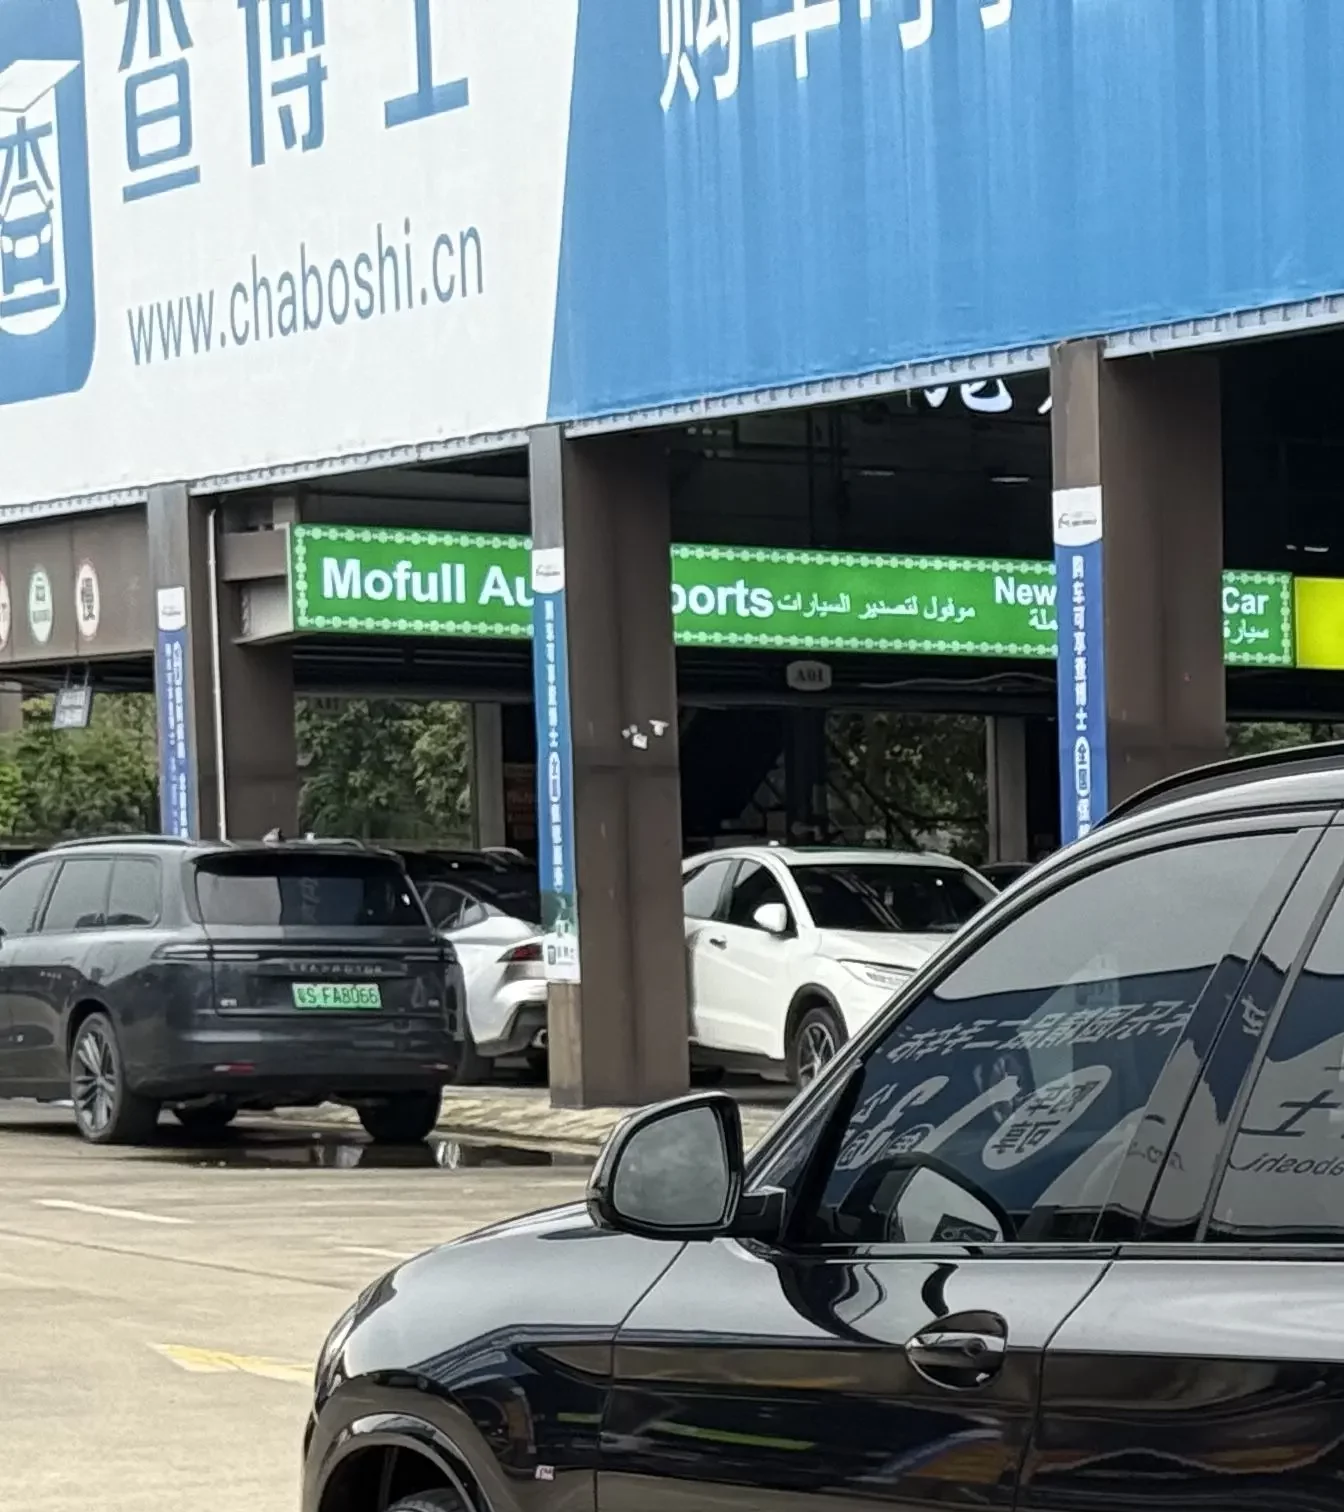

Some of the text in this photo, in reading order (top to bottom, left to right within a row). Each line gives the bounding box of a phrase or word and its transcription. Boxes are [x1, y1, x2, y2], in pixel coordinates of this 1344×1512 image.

[127, 217, 485, 366] www.chaboshi.cn
[322, 556, 467, 605] Mofull
[1222, 586, 1270, 616] Car
